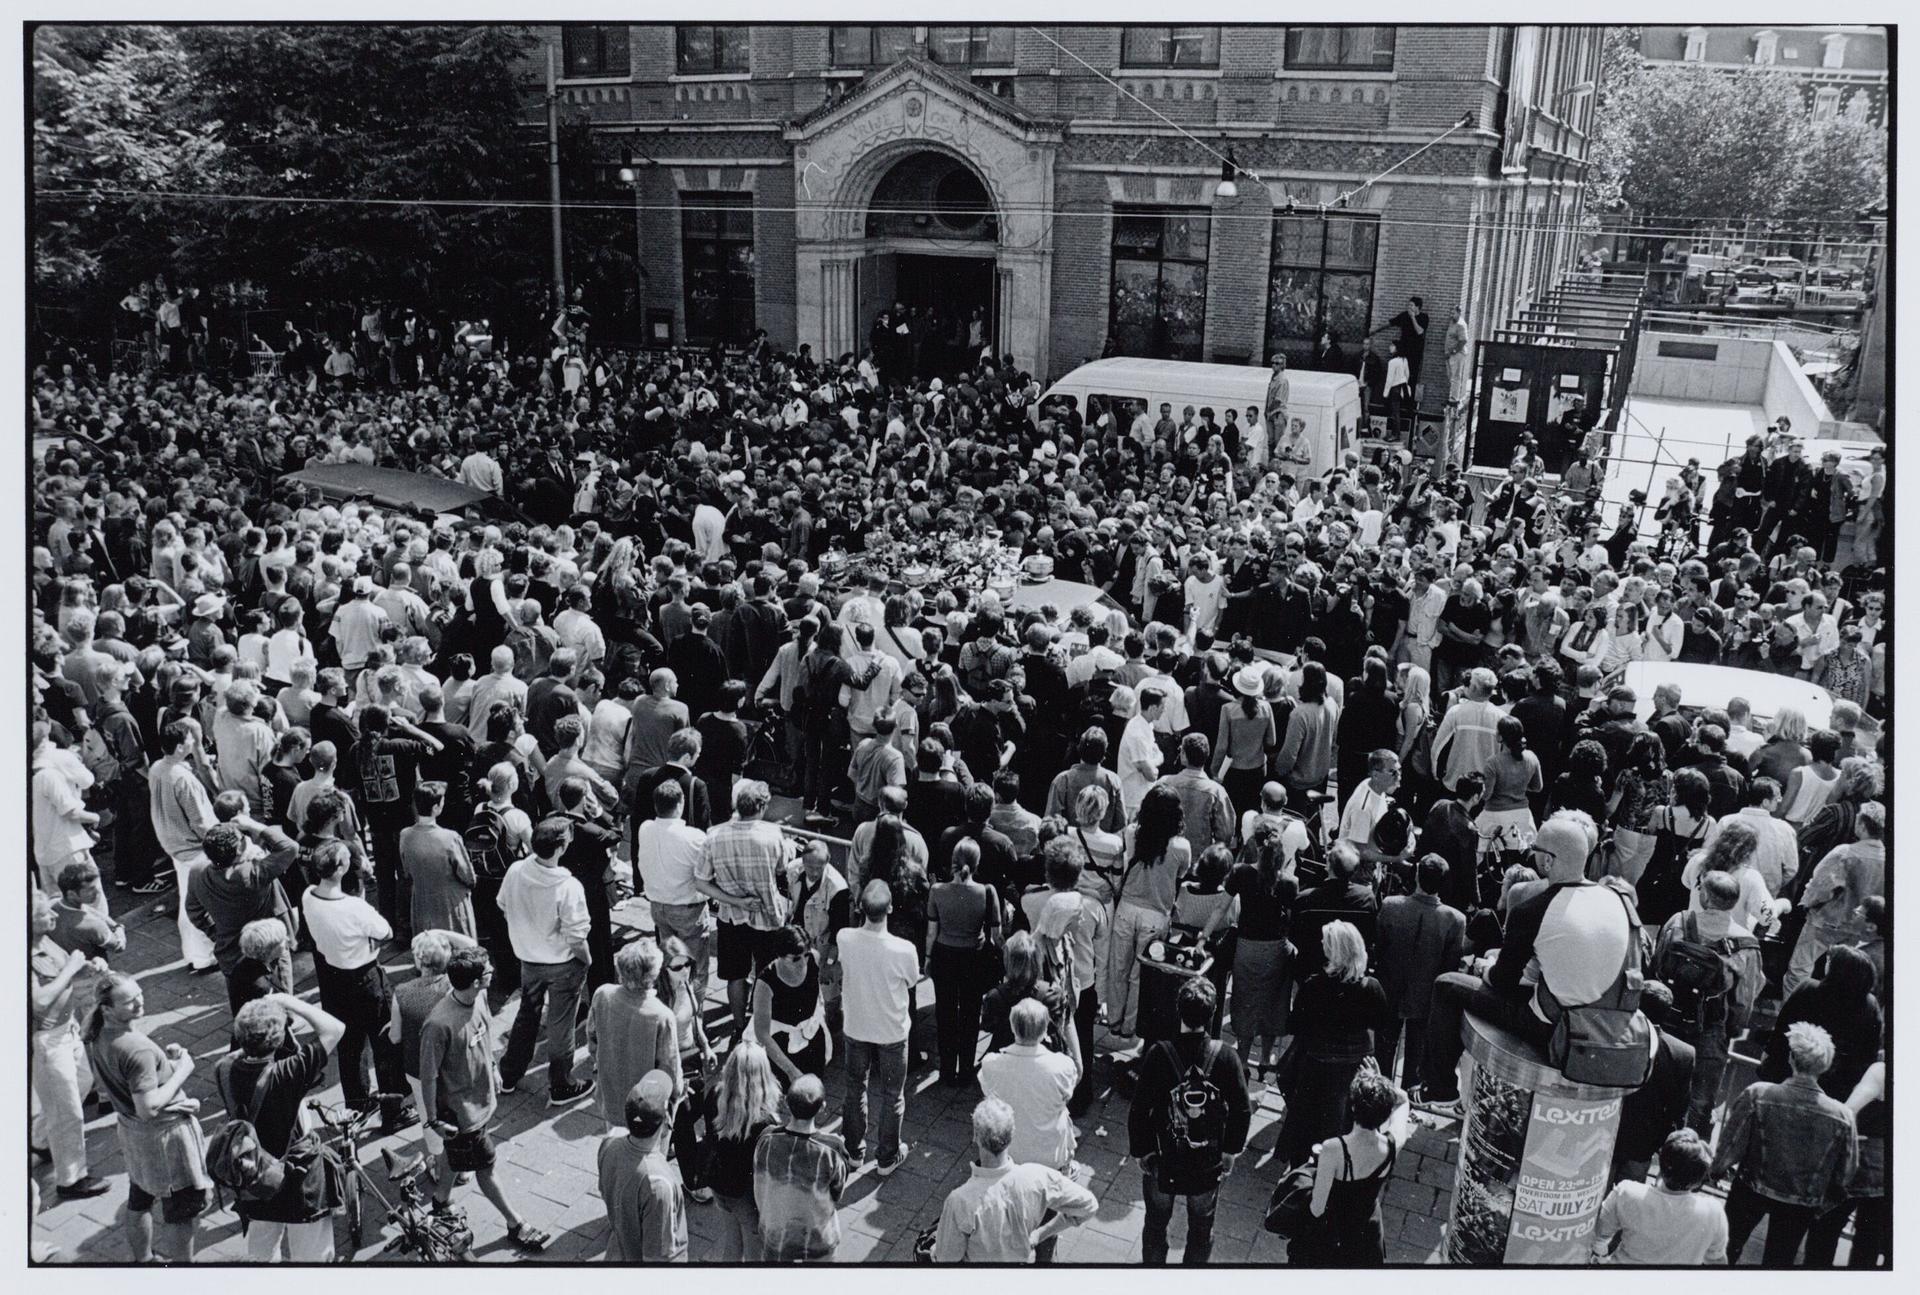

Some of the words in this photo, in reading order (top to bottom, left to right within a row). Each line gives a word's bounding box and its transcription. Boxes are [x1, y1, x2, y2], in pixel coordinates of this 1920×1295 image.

[1521, 1175, 1555, 1190] OPEN
[1517, 1196, 1546, 1213] SAT
[1545, 1200, 1585, 1217] JULY
[1585, 1192, 1599, 1210] 21
